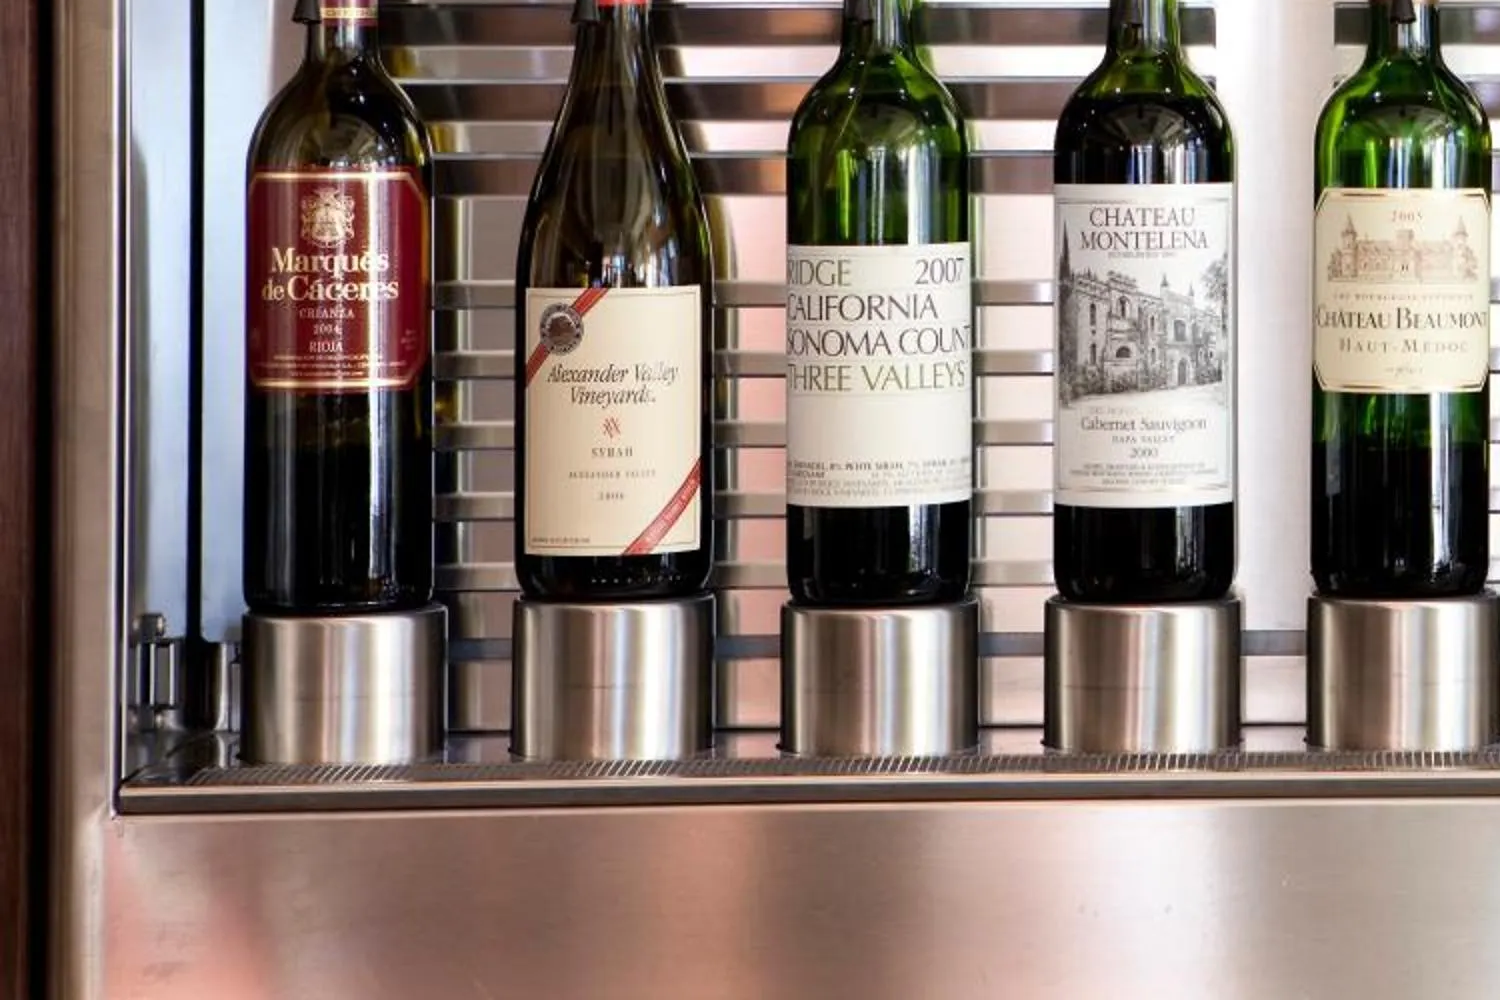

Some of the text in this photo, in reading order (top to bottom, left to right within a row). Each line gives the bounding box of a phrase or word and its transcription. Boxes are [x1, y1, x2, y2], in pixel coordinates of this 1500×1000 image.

[1089, 207, 1196, 227] CHATEAU
[1081, 230, 1210, 251] MONTELENA
[916, 256, 965, 286] 2007
[262, 275, 400, 301] de Cáceres
[299, 306, 355, 319] CRIANZA
[789, 294, 940, 321] CALIFORNIA
[1397, 306, 1488, 329] BEAUMONT
[309, 340, 343, 353] RIOJA
[788, 328, 892, 356] SONOMA
[547, 361, 679, 387] Alexander Valley
[788, 360, 967, 391] THREE VALLEYS
[1081, 415, 1207, 434] Cabernet Sauvignon
[591, 446, 634, 458] SYRAH
